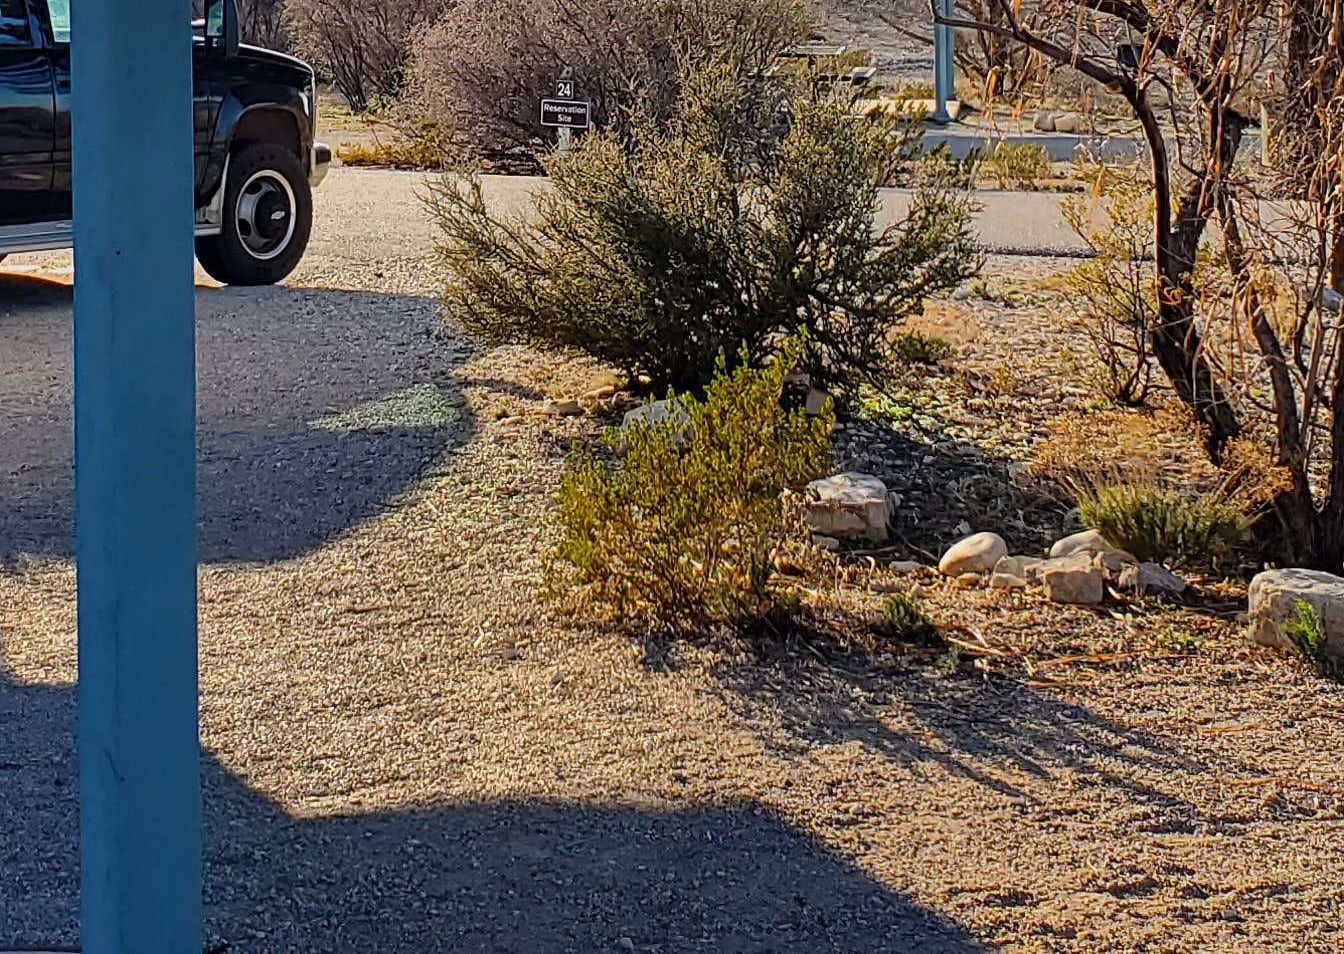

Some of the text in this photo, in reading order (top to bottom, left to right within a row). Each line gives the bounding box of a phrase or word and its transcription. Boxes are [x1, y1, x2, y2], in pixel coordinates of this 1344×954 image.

[557, 82, 571, 97] 24
[543, 103, 587, 114] Reservation
[557, 114, 572, 123] Site
